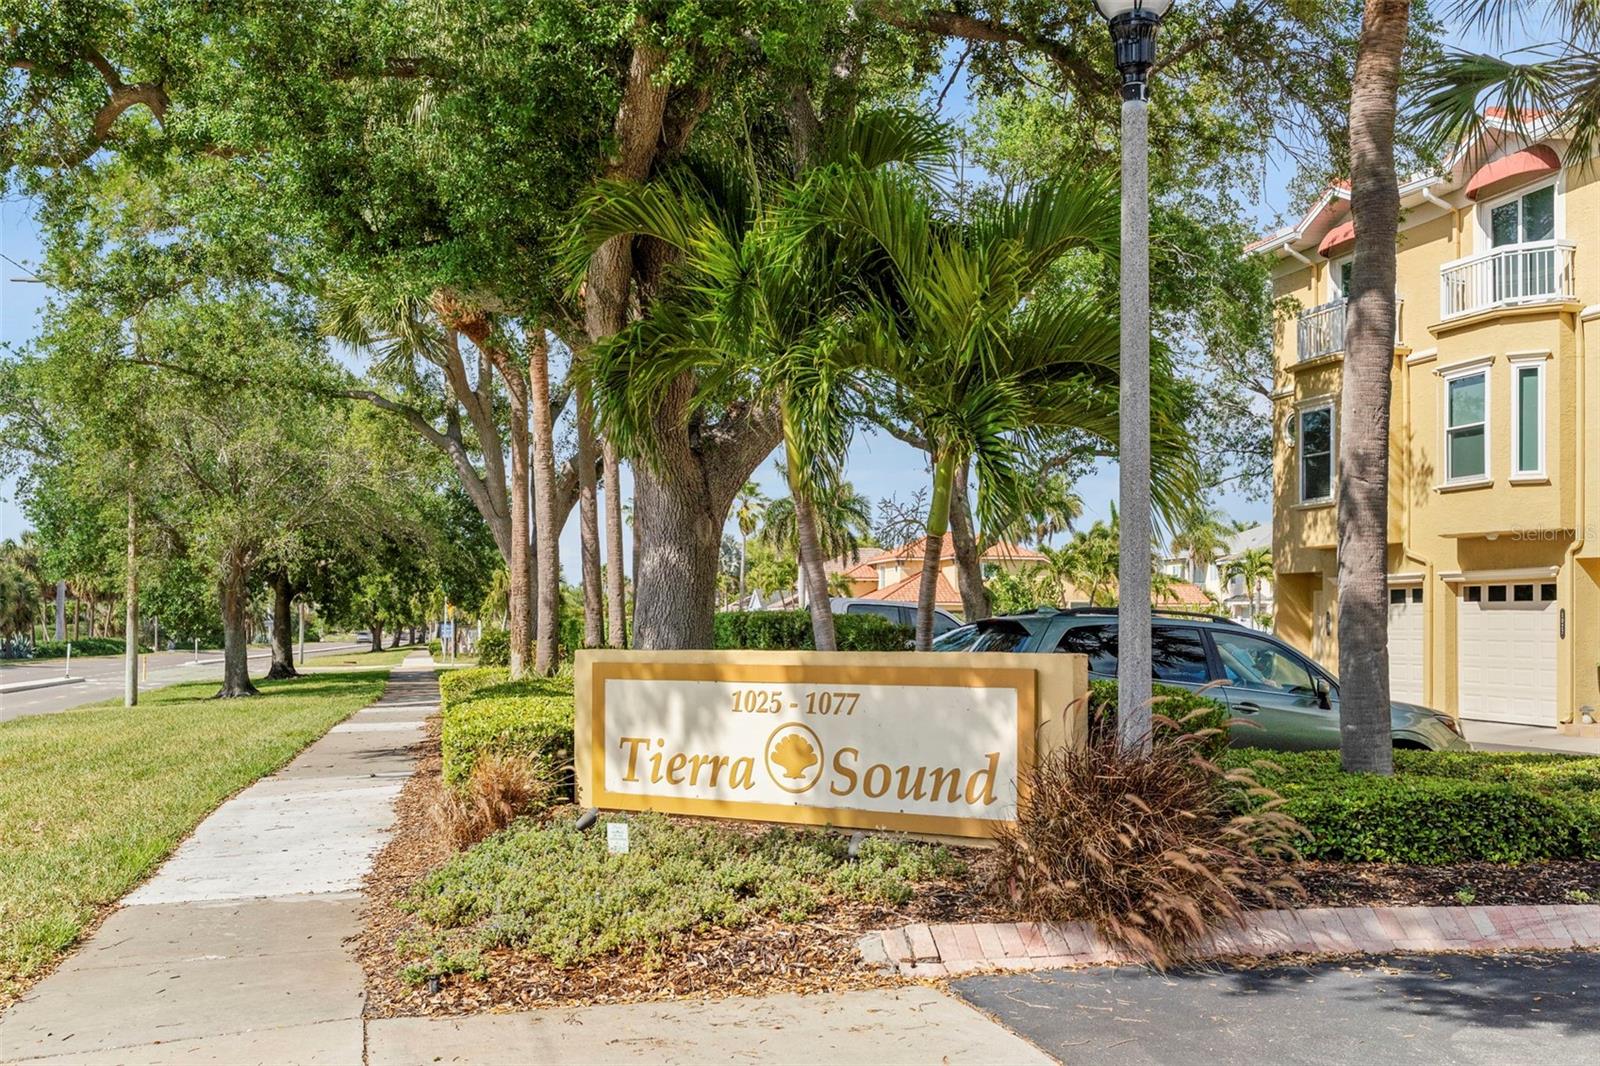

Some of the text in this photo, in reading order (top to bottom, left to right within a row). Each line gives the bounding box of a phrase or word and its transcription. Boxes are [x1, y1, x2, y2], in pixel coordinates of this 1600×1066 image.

[731, 690, 783, 714] 1025
[805, 691, 861, 716] 1077
[619, 736, 1000, 806] Tierra Sound
